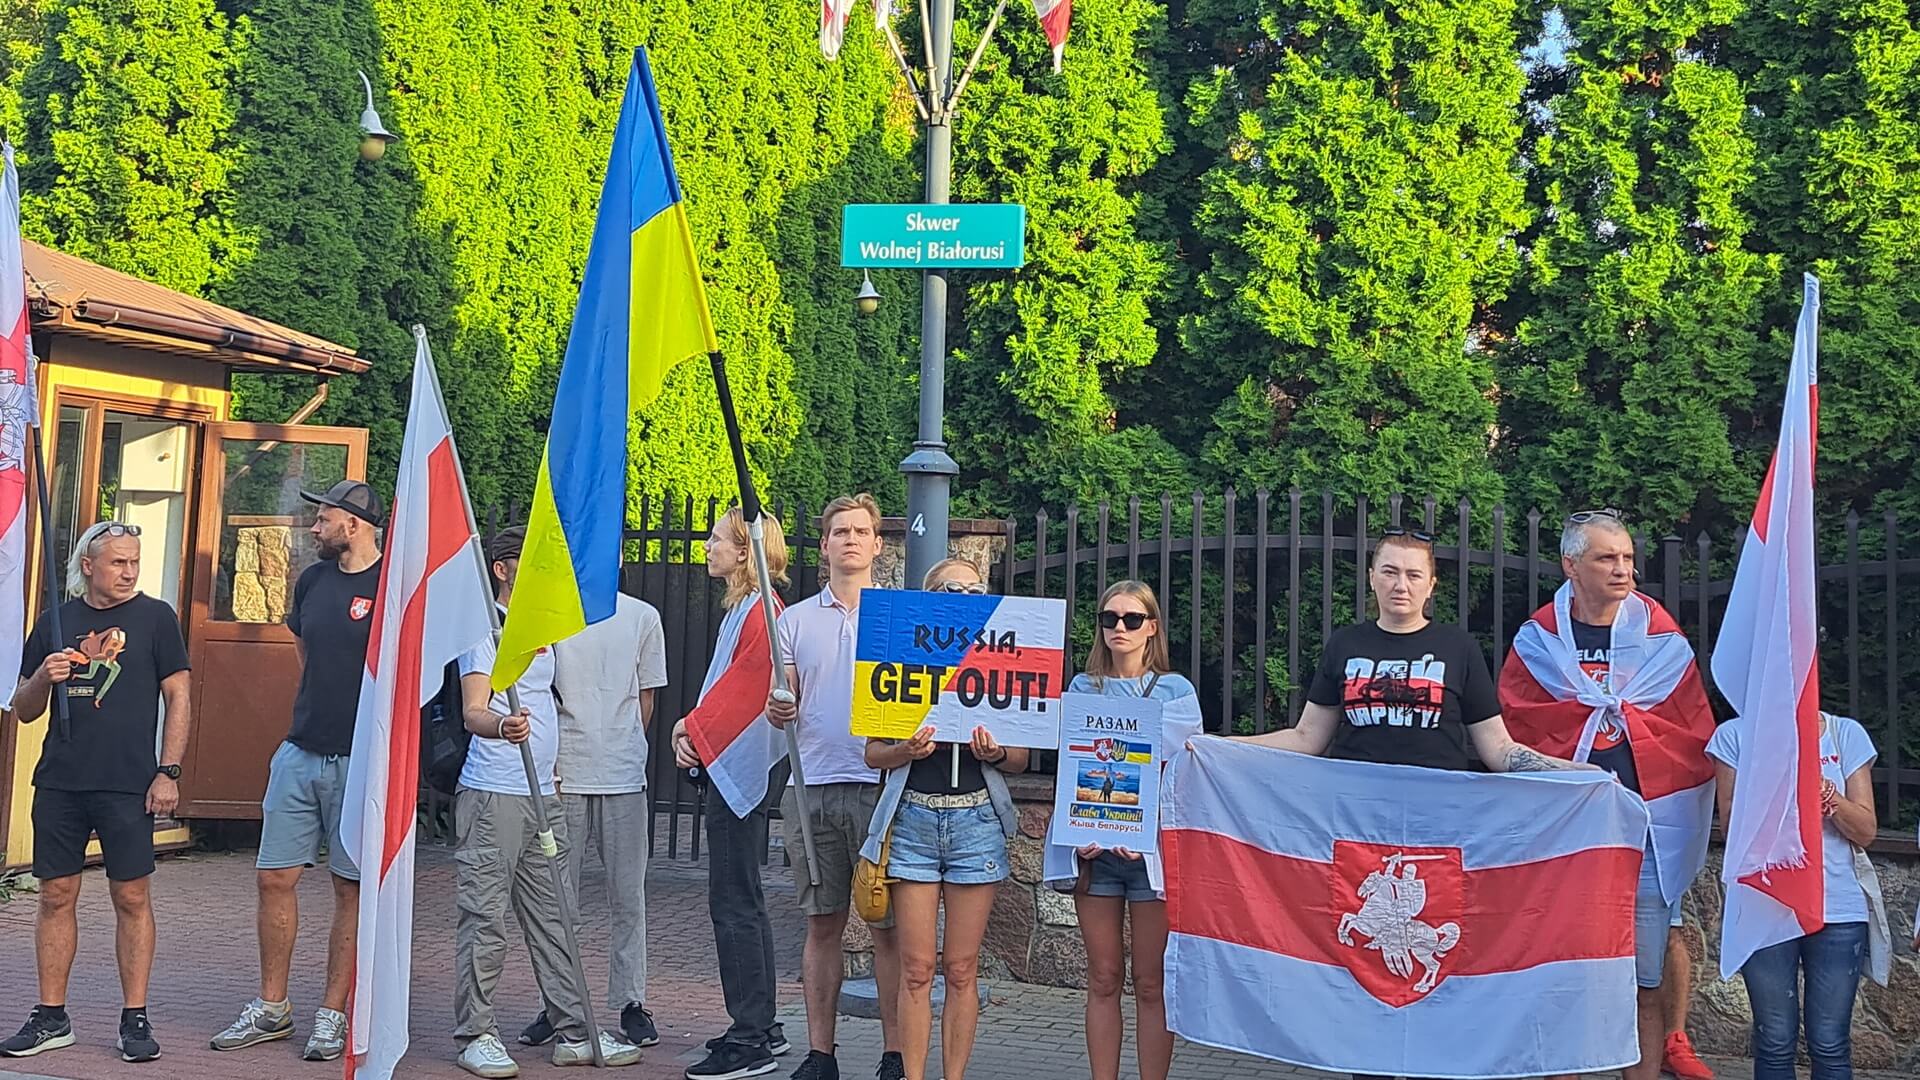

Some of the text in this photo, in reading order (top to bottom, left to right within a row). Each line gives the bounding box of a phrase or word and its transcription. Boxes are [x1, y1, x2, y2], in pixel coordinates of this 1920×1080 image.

[906, 212, 960, 232] Skwer
[860, 241, 1005, 263] Wolnej Białorusi
[911, 513, 926, 536] 4
[914, 624, 1022, 659] RUSSIA,
[870, 662, 1049, 712] GET OUT!
[1086, 715, 1138, 731] РАЗАМ
[1070, 804, 1143, 821] Слава Україні!
